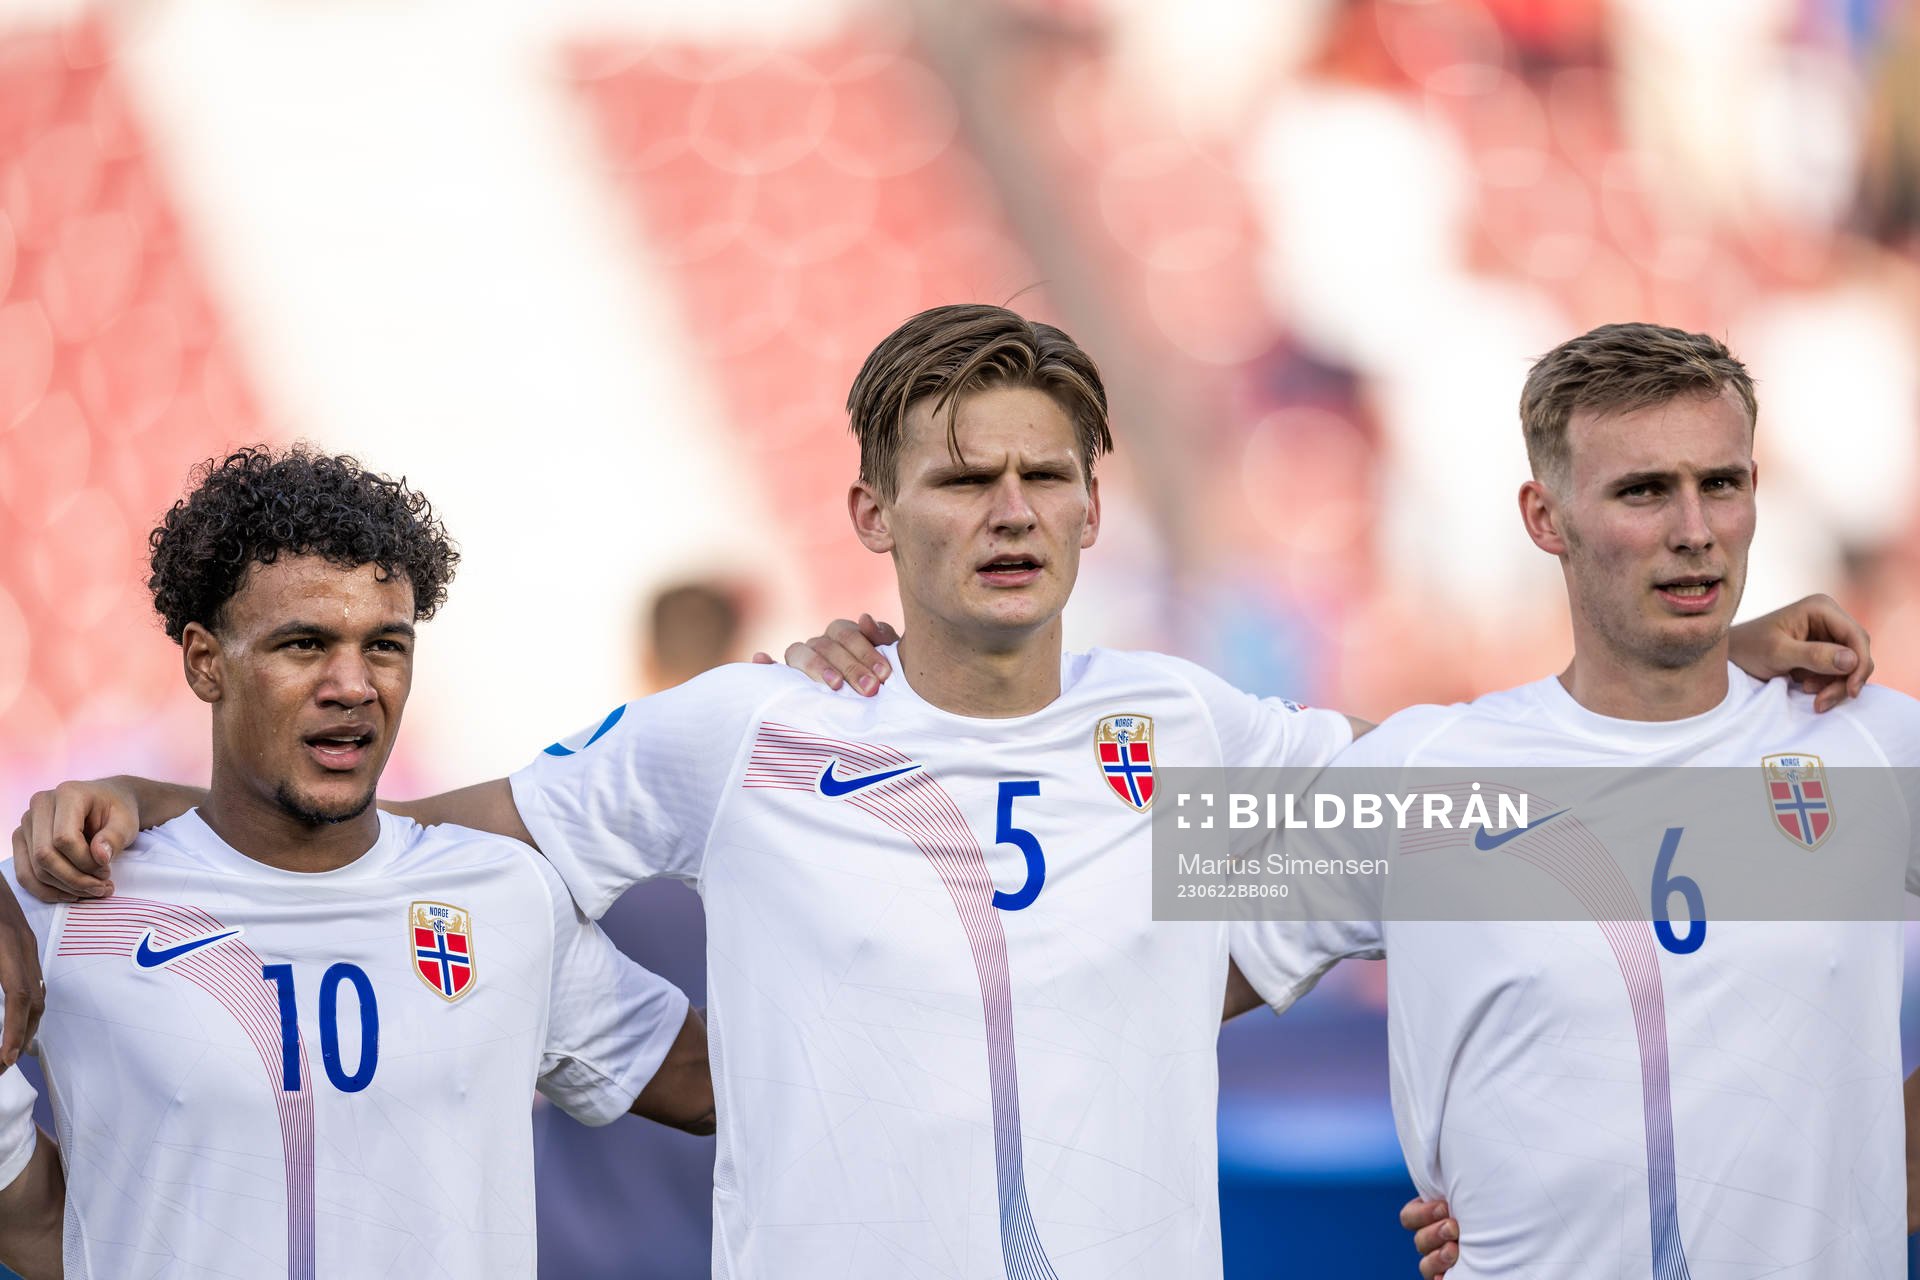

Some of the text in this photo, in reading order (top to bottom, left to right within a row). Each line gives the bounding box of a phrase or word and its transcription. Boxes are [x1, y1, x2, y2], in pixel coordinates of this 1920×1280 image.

[1114, 718, 1133, 728] NORGE
[992, 780, 1046, 911] 5
[1651, 827, 1706, 955] 6
[429, 906, 449, 919] NORGE
[262, 962, 379, 1093] 10
